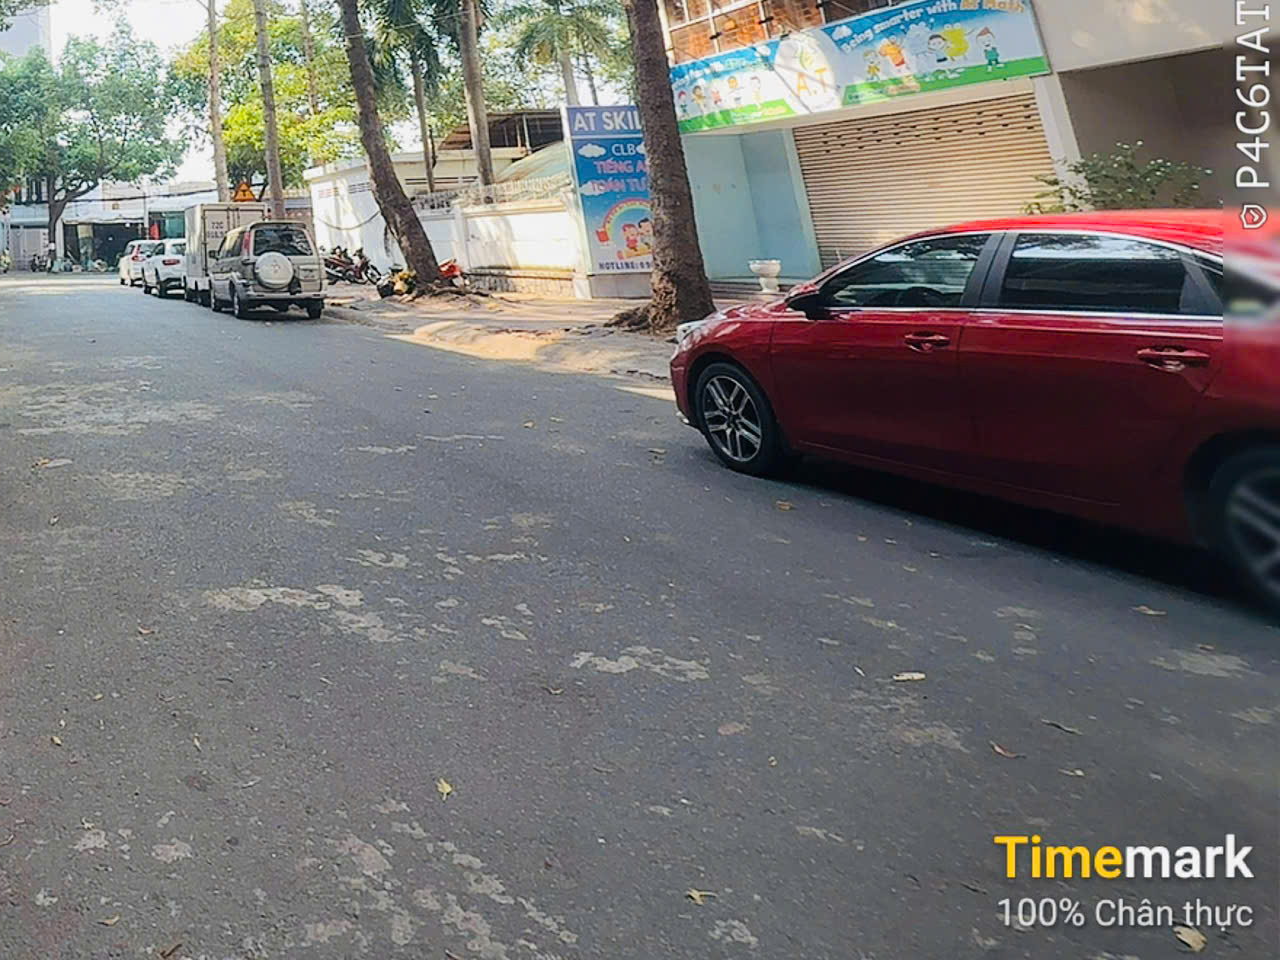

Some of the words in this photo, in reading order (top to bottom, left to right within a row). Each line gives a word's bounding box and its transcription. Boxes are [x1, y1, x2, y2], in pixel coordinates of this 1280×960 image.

[841, 28, 874, 54] Being
[873, 6, 925, 33] smarter
[574, 112, 596, 132] AT
[602, 110, 642, 130] SKIL
[611, 144, 636, 156] CLB
